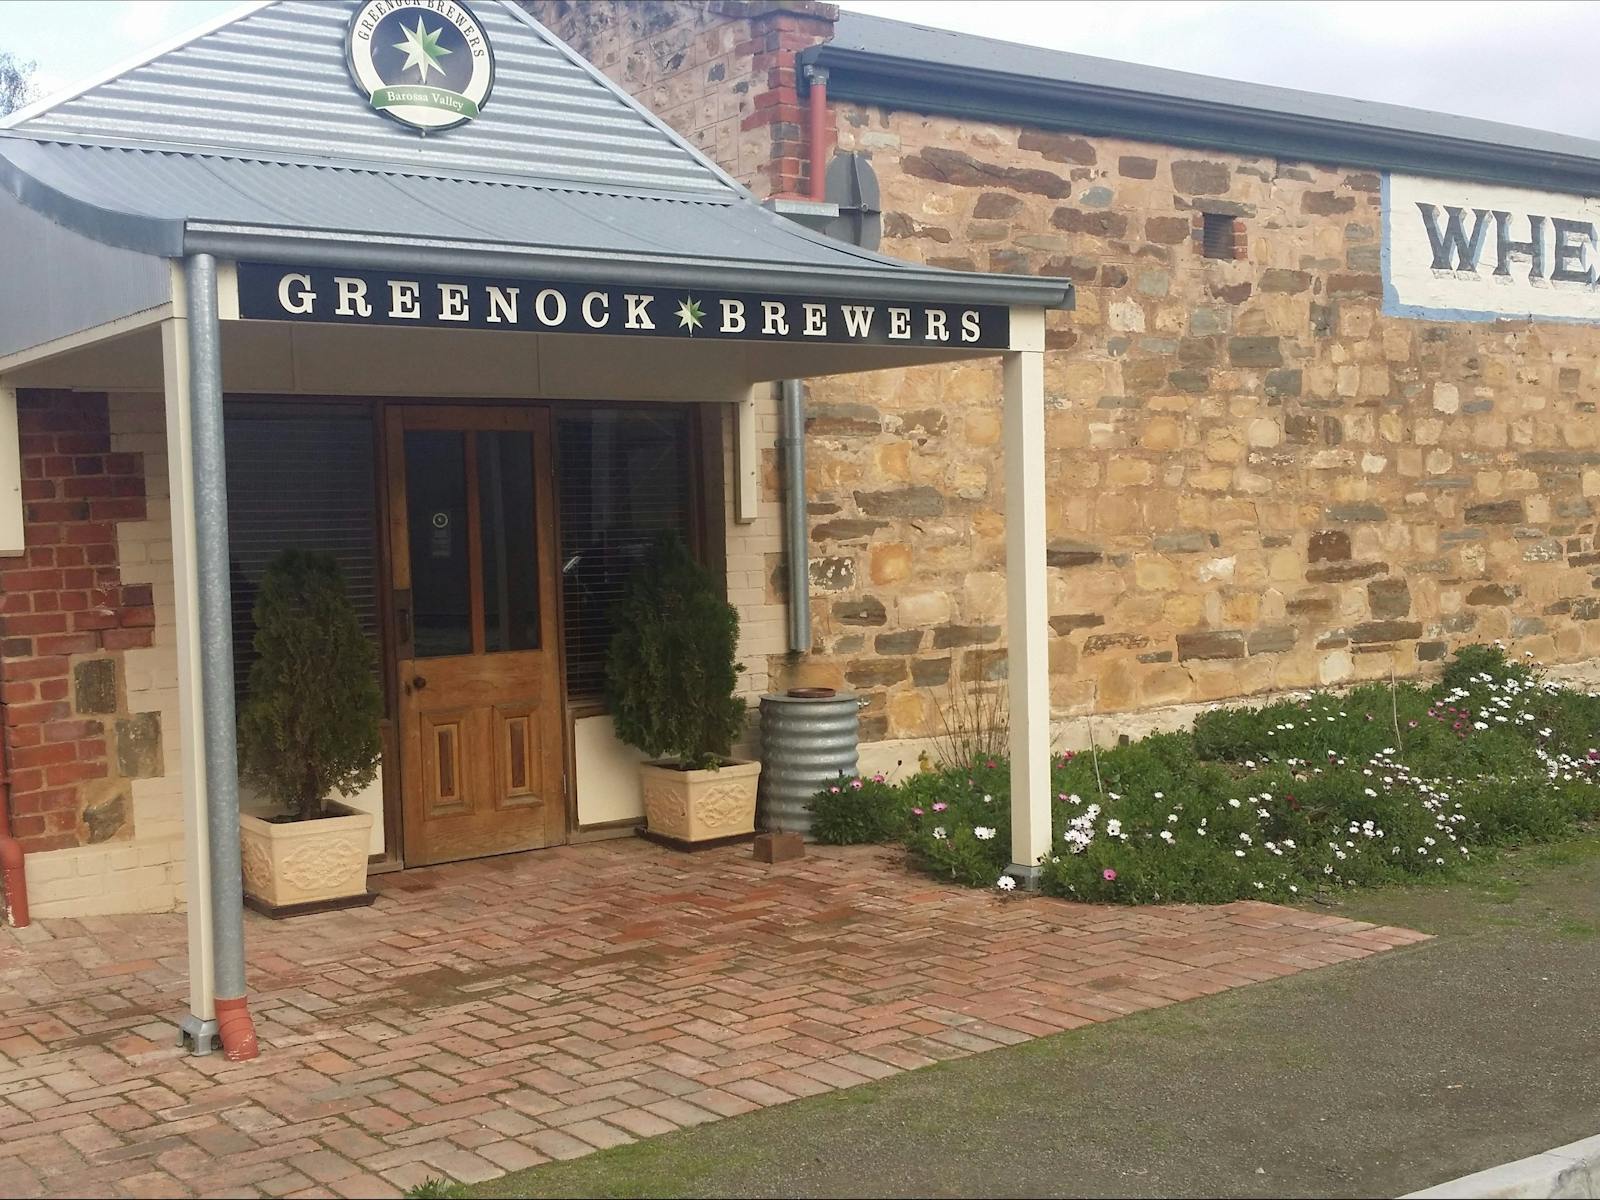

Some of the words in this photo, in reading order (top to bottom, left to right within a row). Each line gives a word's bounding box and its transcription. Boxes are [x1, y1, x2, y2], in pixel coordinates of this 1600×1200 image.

[427, 0, 485, 57] BREWERS
[387, 91, 429, 102] Barossa
[432, 92, 463, 111] Valley
[1414, 202, 1600, 286] WHE
[277, 273, 656, 330] GREENOCK
[719, 298, 981, 342] BREWERS
